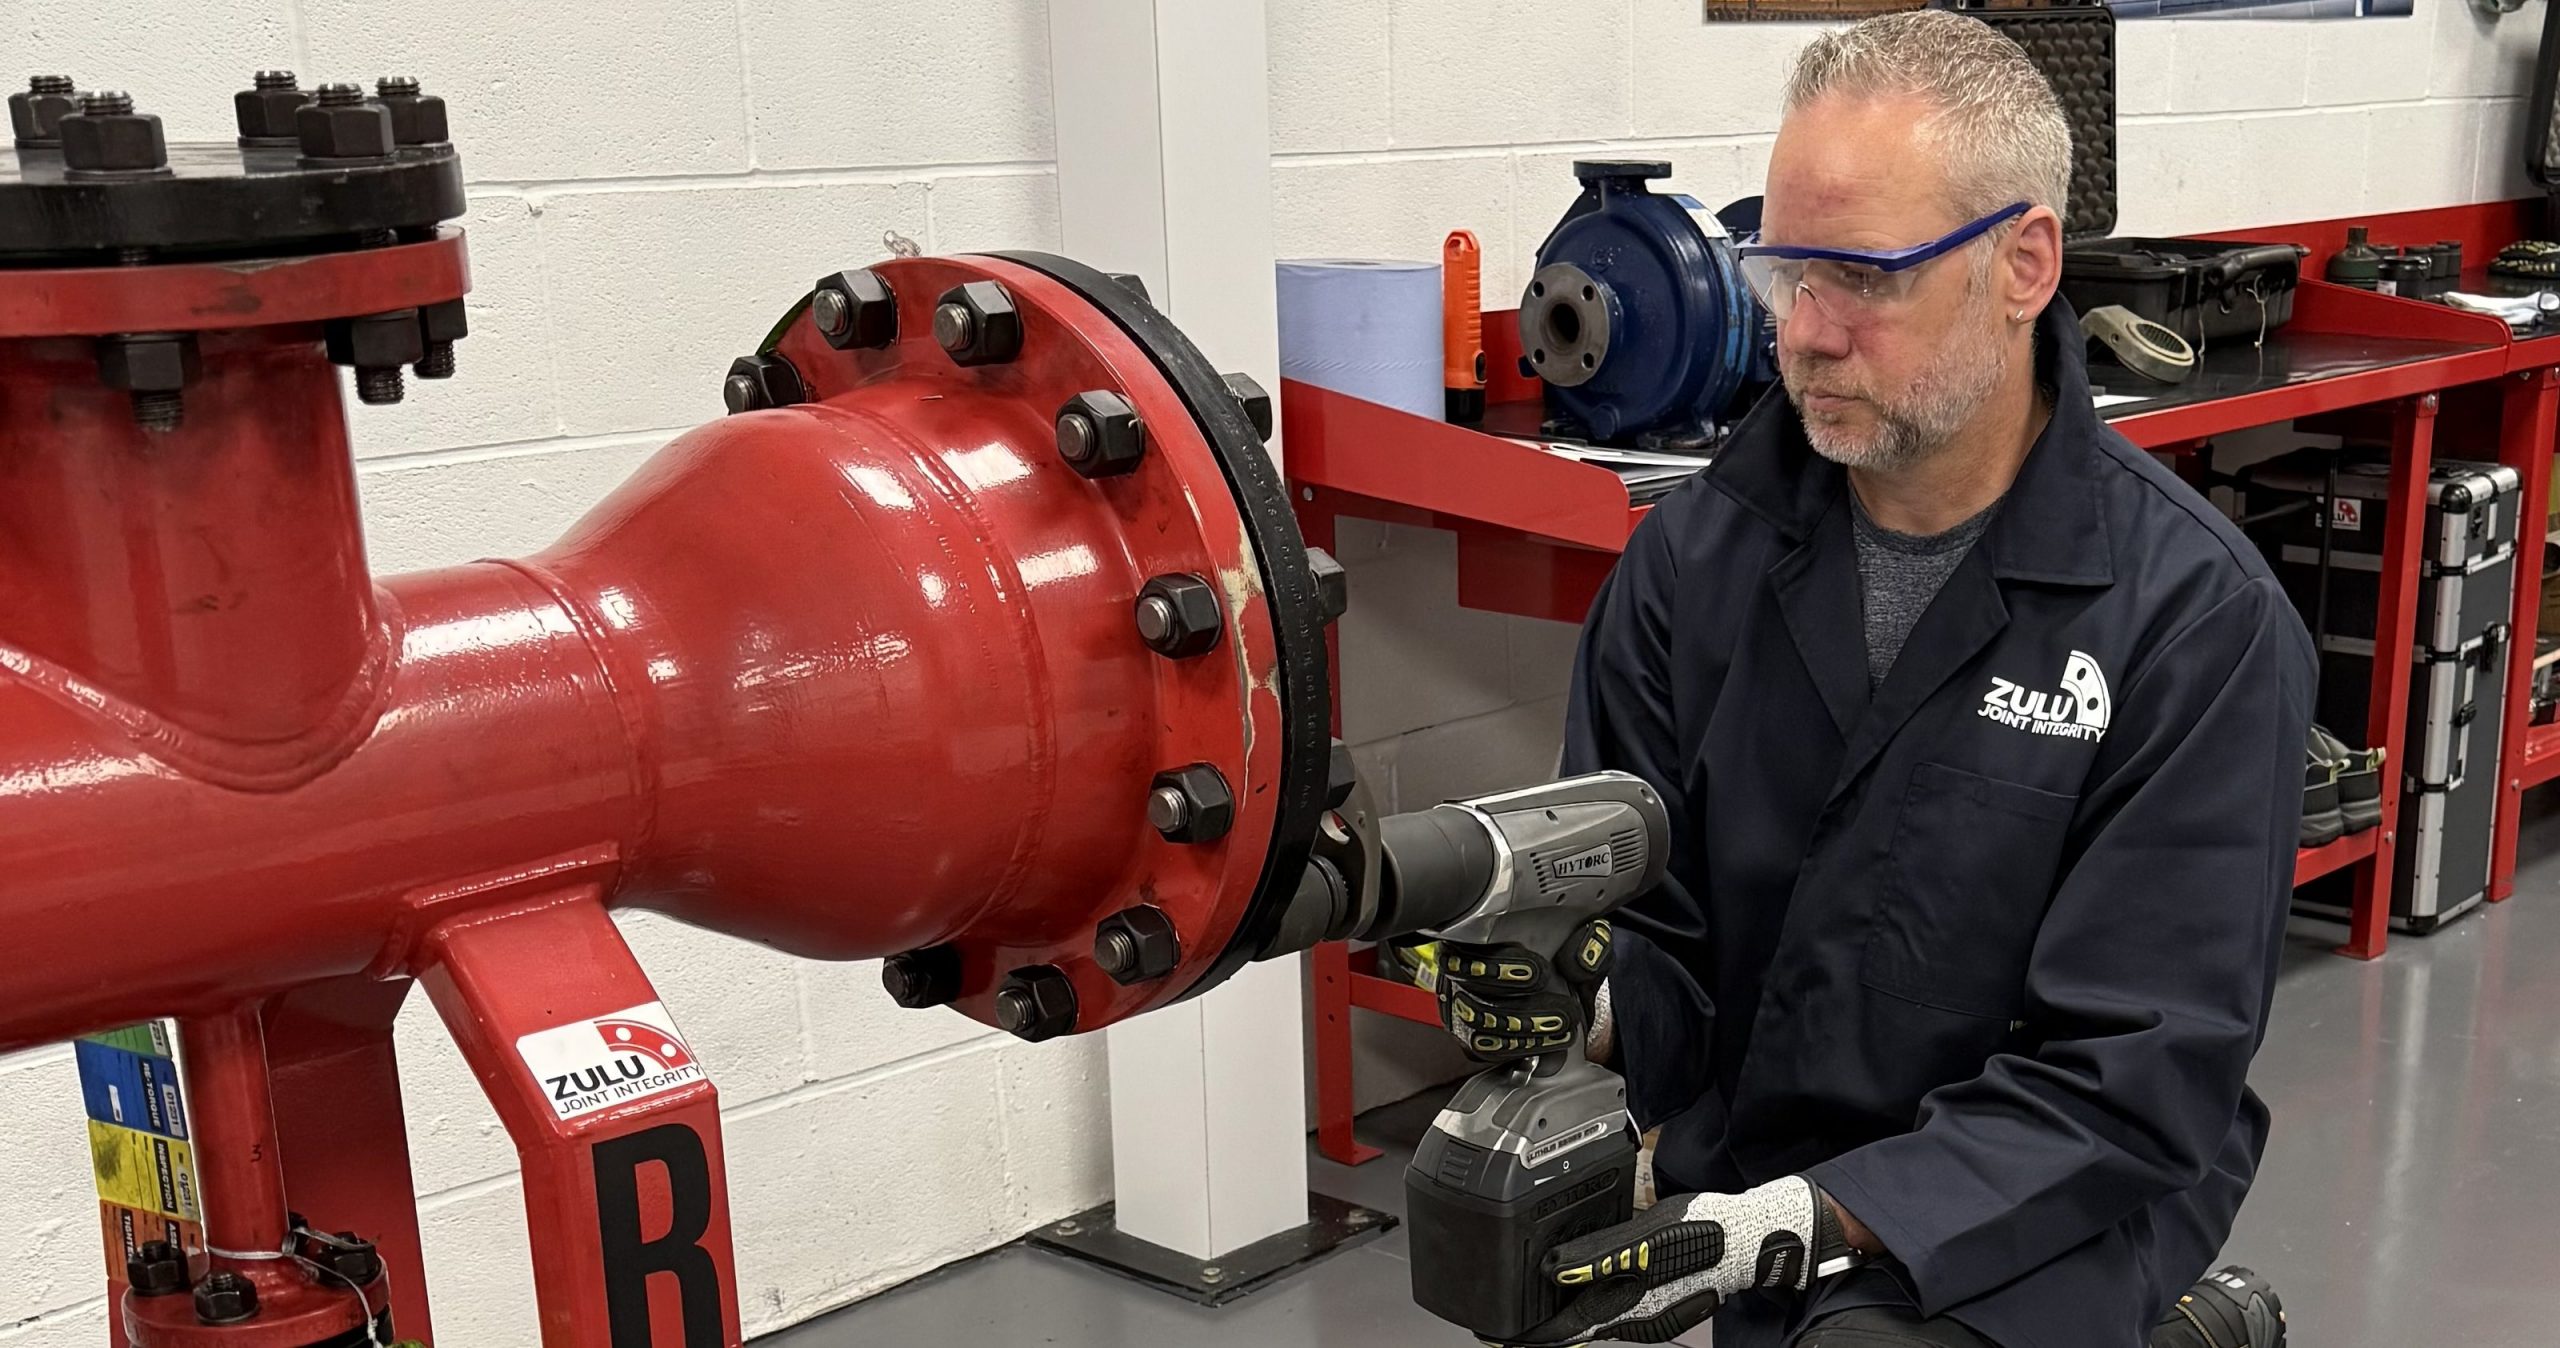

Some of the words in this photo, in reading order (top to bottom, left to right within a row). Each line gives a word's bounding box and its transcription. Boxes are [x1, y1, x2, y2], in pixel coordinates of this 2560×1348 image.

[1984, 676, 2075, 722] ZULU
[1977, 703, 2032, 731] JOINT
[2031, 720, 2106, 743] INTEGRITY
[1558, 852, 1610, 875] HYTORC
[546, 1055, 646, 1101] ZULU
[560, 1090, 610, 1114] JOINT
[615, 1065, 702, 1098] INTEGRITY
[157, 1142, 174, 1209] INSPECTION
[592, 1123, 725, 1348] R
